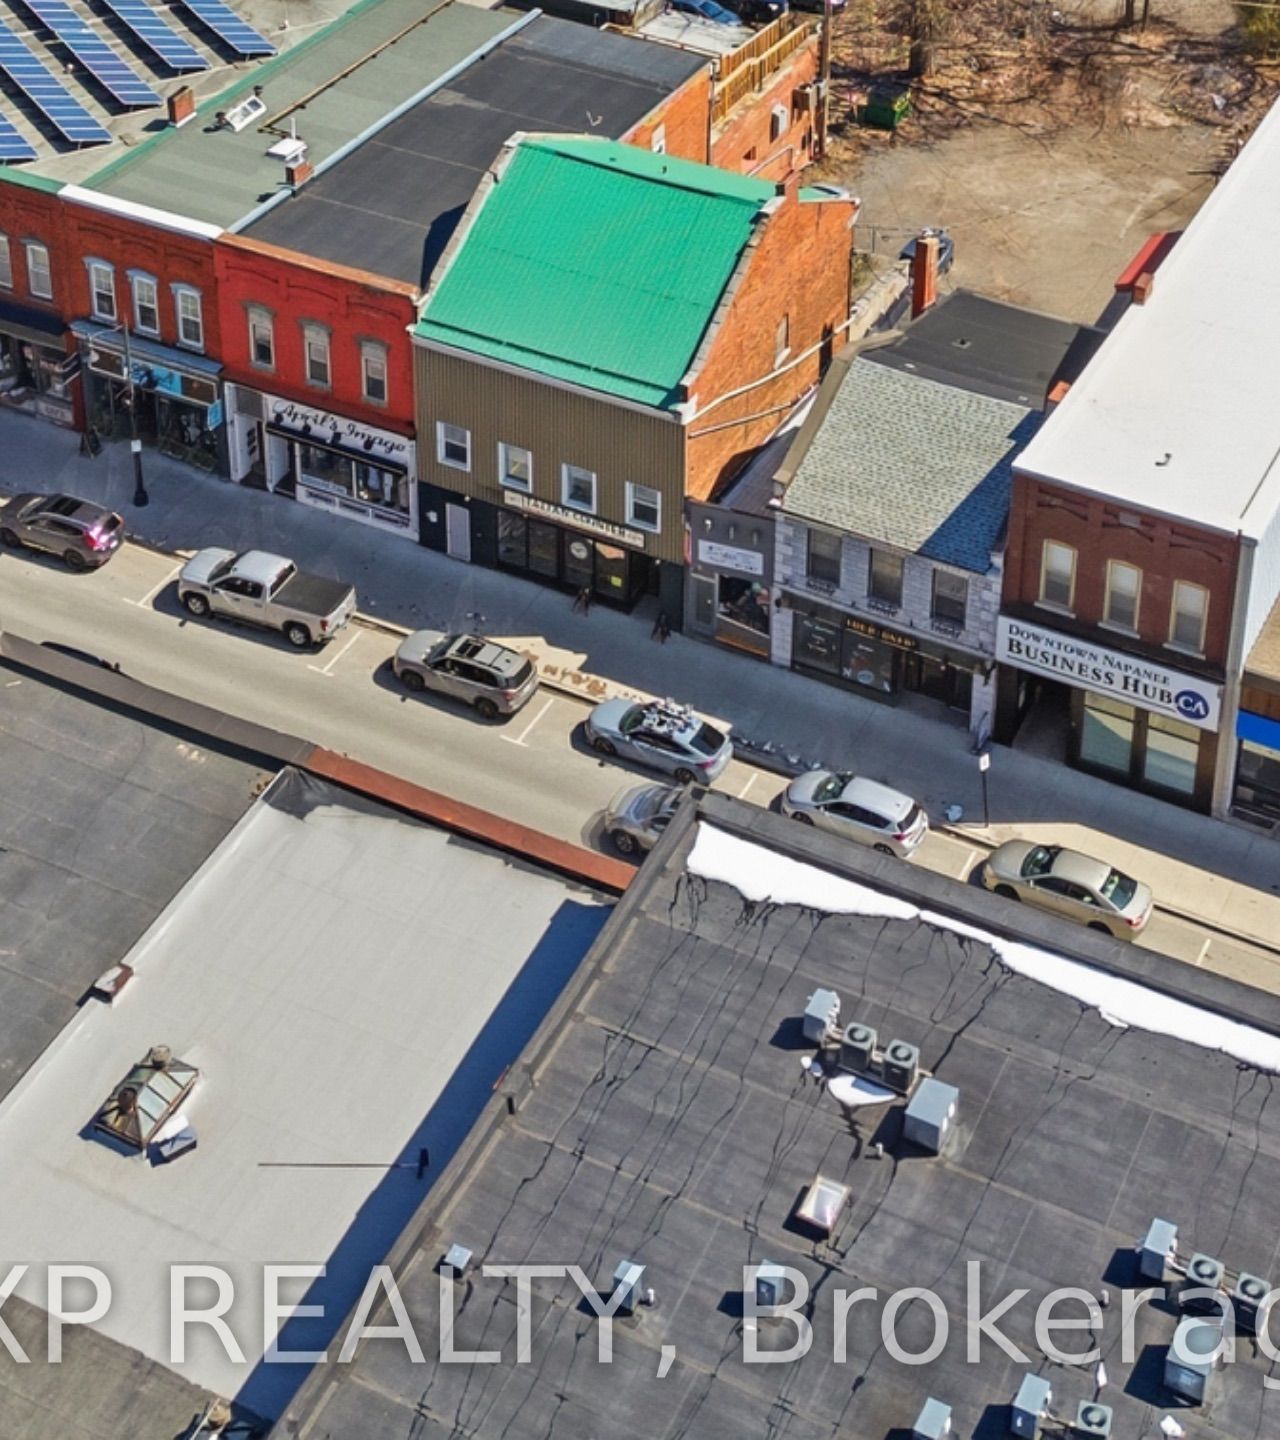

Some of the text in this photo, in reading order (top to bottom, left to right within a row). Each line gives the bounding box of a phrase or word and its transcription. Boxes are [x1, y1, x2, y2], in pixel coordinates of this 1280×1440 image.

[1007, 638, 1173, 704] BUSINESS HUB
[1008, 623, 1170, 685] DOWNTOWN NAPANEE
